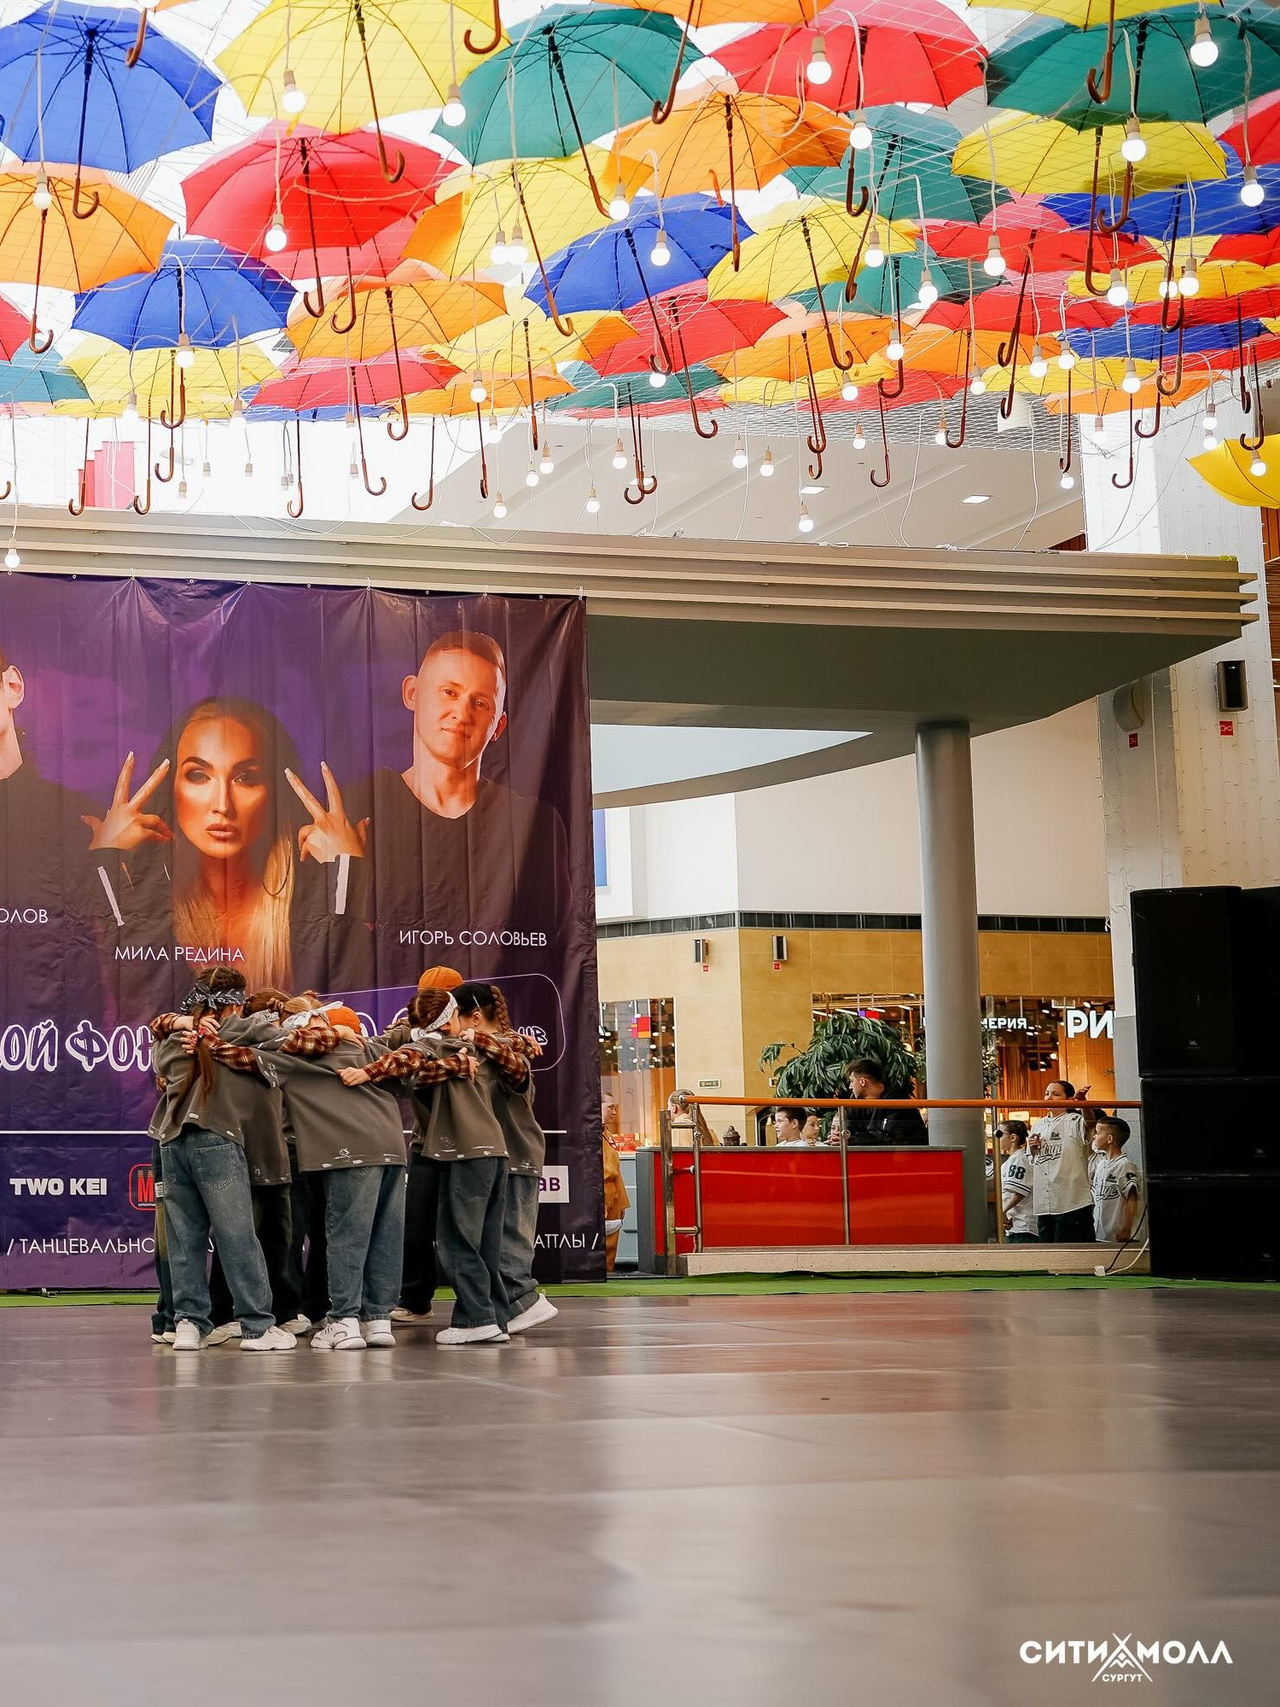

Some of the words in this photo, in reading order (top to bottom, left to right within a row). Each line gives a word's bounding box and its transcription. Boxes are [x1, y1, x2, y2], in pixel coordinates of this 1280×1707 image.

[399, 930, 454, 946] ИГОРЬ
[458, 930, 548, 947] СОЛОВЬЕВ
[114, 945, 169, 962] МИЛА
[175, 946, 246, 964] РЕДИНА
[1066, 1009, 1116, 1039] РИ
[9, 1177, 64, 1196] TWO
[70, 1177, 108, 1196] KEI
[19, 1237, 155, 1257] ТАНЦЕВАЛЬНО
[533, 1233, 586, 1249] АТТЛЫ
